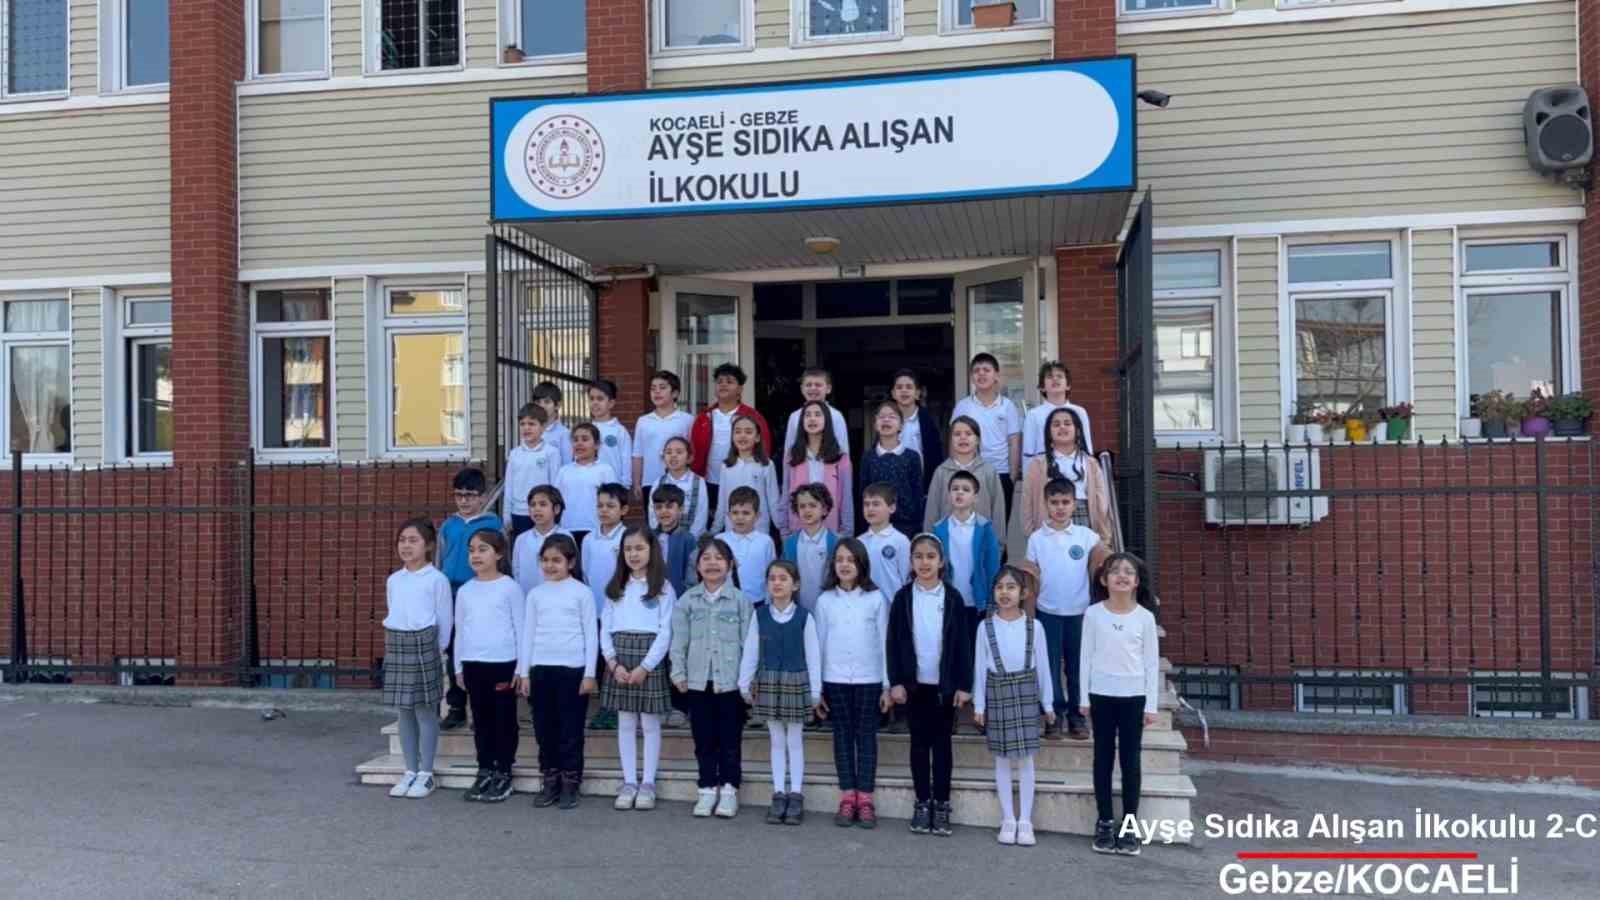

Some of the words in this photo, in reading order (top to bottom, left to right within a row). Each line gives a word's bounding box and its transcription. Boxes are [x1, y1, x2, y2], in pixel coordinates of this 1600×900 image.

[650, 111, 725, 132] KOCAELİ
[740, 110, 798, 126] GEBZE
[647, 131, 724, 165] AYŞE
[733, 125, 834, 156] SIDIKA
[840, 115, 954, 153] ALIŞAN
[649, 170, 799, 203] İLKOKULU
